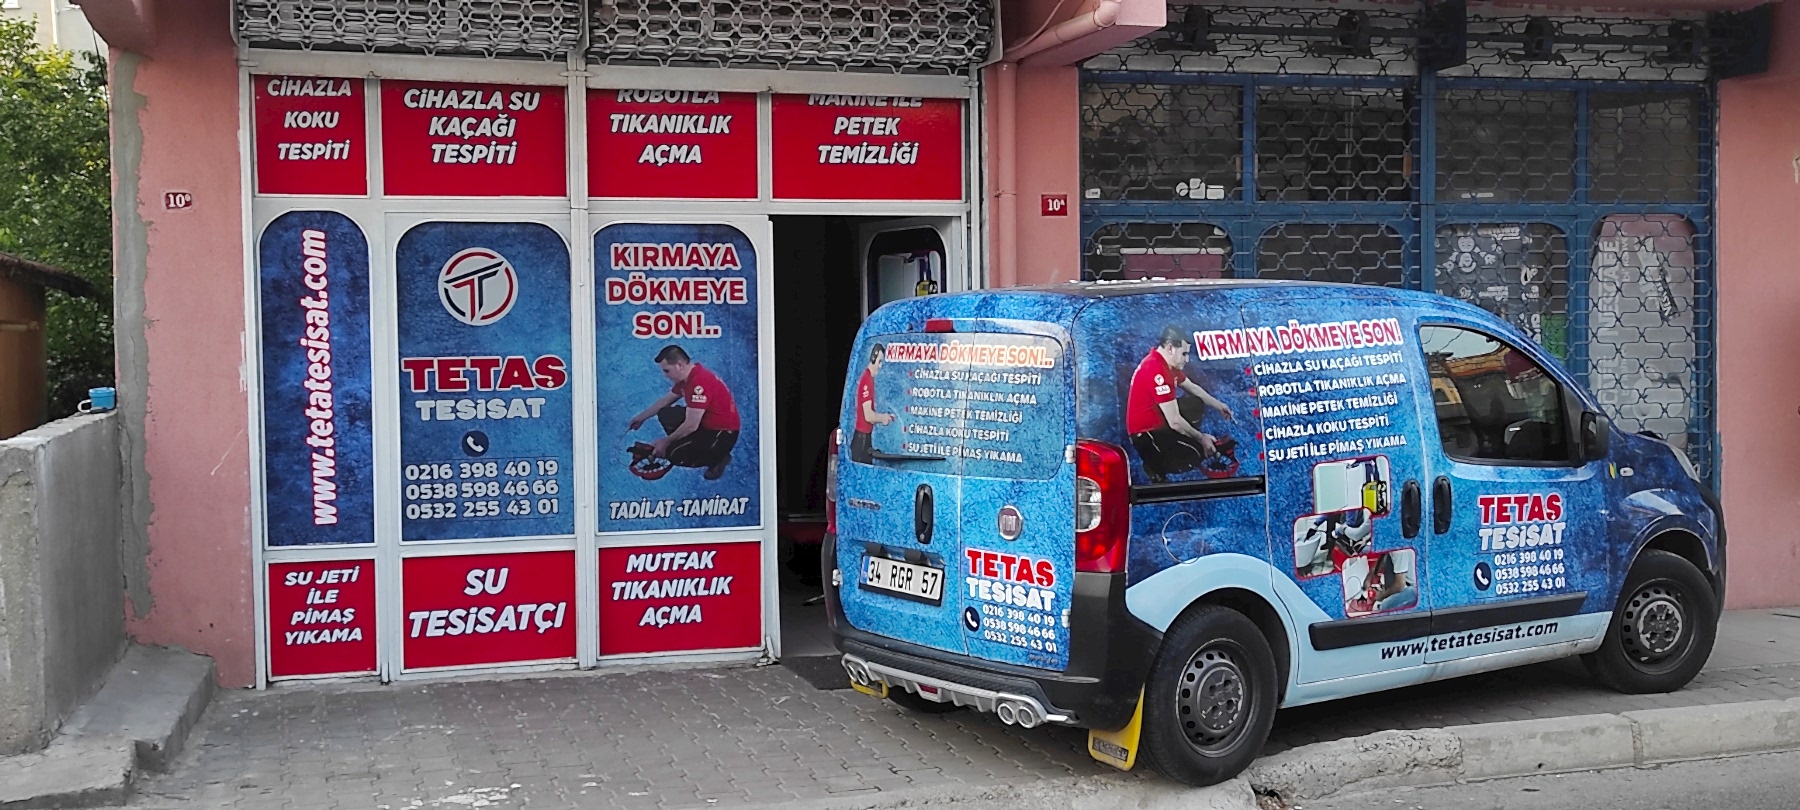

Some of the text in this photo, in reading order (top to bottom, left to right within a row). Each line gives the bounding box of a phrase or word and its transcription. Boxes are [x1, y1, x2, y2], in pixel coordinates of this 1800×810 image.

[267, 75, 352, 97] CİHAZLA
[616, 88, 721, 104] ROBOTLA
[508, 91, 541, 111] SU
[283, 111, 340, 129] KOKU
[428, 113, 518, 140] KAÇAĞI
[609, 113, 732, 134] TIKANIKLIK
[833, 116, 901, 136] PETEK
[277, 139, 351, 161] TESPİTİ
[431, 140, 518, 165] TESPİTİ
[637, 144, 703, 167] AÇMA
[818, 141, 920, 165] TEMİZLİĞİ
[610, 243, 741, 270] KIRMAYA
[607, 274, 746, 304] DÖKMEYE
[632, 311, 721, 338] SON!..
[1195, 327, 1278, 360] KIRMAYA
[1277, 320, 1361, 353] DÖKMEYE
[885, 343, 939, 364] KIRMAYA
[939, 340, 1006, 365] DÖKMEYE
[1254, 350, 1403, 376] CİHAZLA SU KAÇAĞI TESPİTİ
[300, 228, 338, 526] www.tetatesisat.com
[914, 367, 950, 380] CİHAZLA
[951, 370, 963, 381] SU
[1002, 371, 1041, 385] TESPİTİ
[1259, 373, 1407, 398] ROBOTLA TIKANIKLIK AÇMA
[912, 388, 951, 400] ROBOTLA
[1006, 393, 1037, 406] AÇMA
[1262, 391, 1398, 418] MAKİNE PETEK TEMİZLİĞİ
[910, 406, 1023, 424] MAKİNE PETEK TEMİZLİĞİ
[908, 422, 1010, 442] CİHAZLA KOKU TESPİTİ
[1266, 413, 1390, 440] CİHAZLA KOKU TESPİTİ
[908, 442, 920, 453] SU
[984, 450, 1023, 464] YIKAMA
[1268, 434, 1407, 462] SU JETİ İLE PİMAŞ YIKAMA
[405, 460, 559, 481] 0216 398 40 19
[405, 479, 559, 500] 0538 598 46 66
[406, 498, 559, 520] 0532 255 43 01
[610, 497, 675, 519] TADİLAT
[626, 550, 717, 573] MUTFAK
[1494, 548, 1564, 566] 0216 398 40 19
[284, 565, 360, 586] SU JETİ
[463, 567, 509, 596] SU
[868, 561, 938, 595] 34 RGR 57
[1495, 562, 1564, 580] 0538 598 46 66
[306, 587, 339, 605] İLE
[611, 576, 734, 601] TIKANIKLIK
[1496, 576, 1566, 594] 0532 255 43 01
[290, 607, 355, 626] PİMAŞ
[638, 604, 703, 629] AÇMA
[982, 604, 1055, 626] 0216 398 40 19
[284, 627, 363, 646] YIKAMA
[983, 617, 1056, 640] 0538 598 46 66
[984, 630, 1058, 653] 0532 255 43 01
[1381, 621, 1558, 660] www.tetatesisat.com
